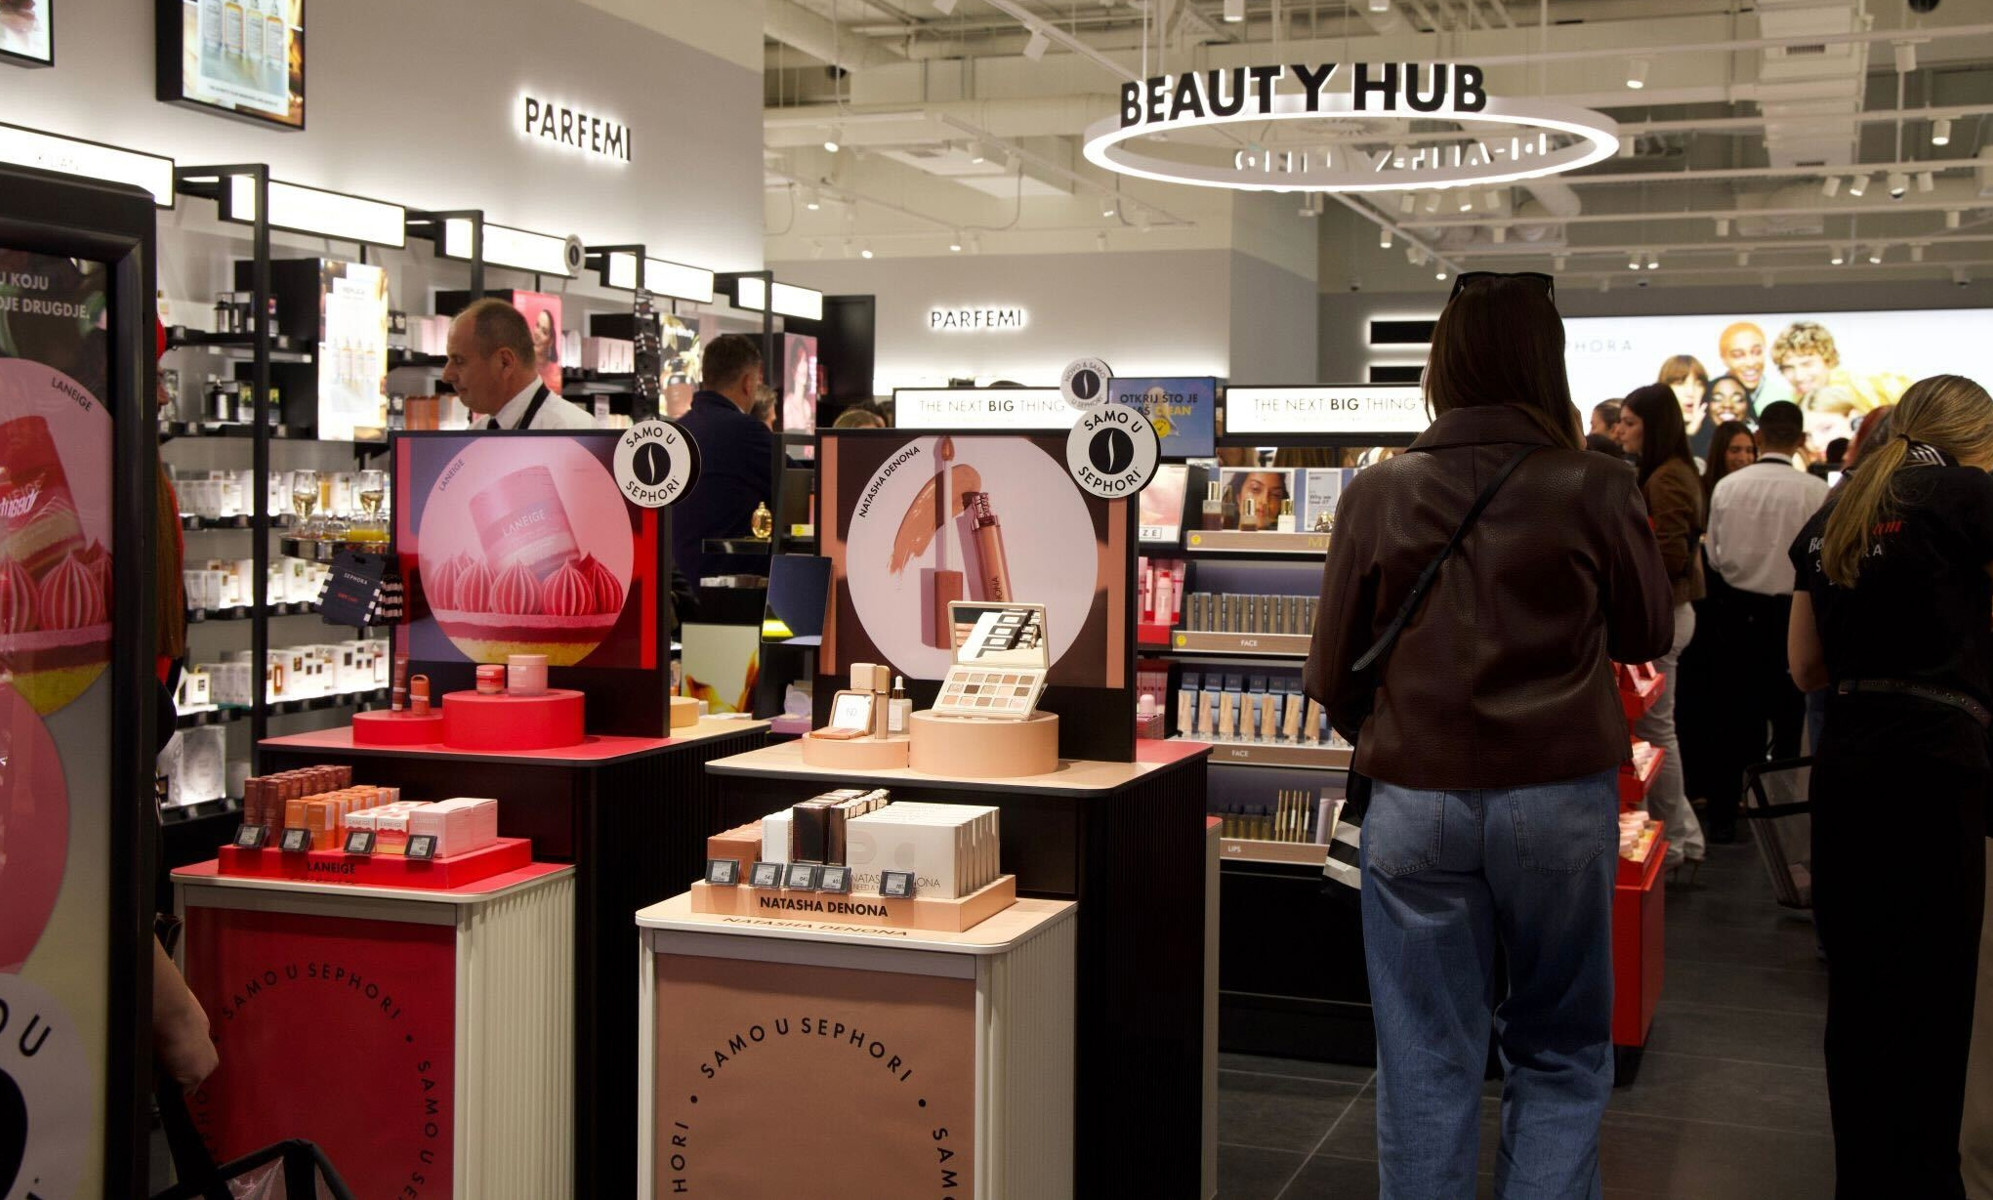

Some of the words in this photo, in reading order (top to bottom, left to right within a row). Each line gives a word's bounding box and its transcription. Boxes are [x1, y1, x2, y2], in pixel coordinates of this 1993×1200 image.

[1121, 64, 1338, 128] BEAUTY
[1353, 63, 1487, 113] HUB
[526, 97, 631, 161] PARFEMI
[11, 273, 48, 290] KOJU
[23, 299, 90, 319] DRUGDJE.
[931, 310, 1021, 328] PARFEMI
[51, 376, 93, 413] LANEIGE
[920, 400, 942, 412] THE
[949, 400, 982, 412] NEXT
[988, 400, 1015, 412] BIG
[1020, 400, 1065, 412] THING
[1120, 394, 1159, 404] OTKRIJ
[1187, 393, 1198, 403] JE
[1255, 398, 1280, 412] THE
[1286, 398, 1324, 411] NEXT
[1330, 398, 1360, 411] BIG
[1084, 411, 1129, 431] SAMO
[1131, 421, 1143, 433] U
[626, 427, 663, 448] SAMO
[665, 433, 676, 445] U
[438, 459, 465, 492] LANEIGE
[859, 476, 886, 518] NATASHA
[884, 446, 921, 477] DENONA
[1078, 465, 1142, 492] SEPHORI
[626, 478, 680, 502] SEPHORI
[503, 508, 547, 536] LANEIGE
[1227, 845, 1242, 853] LIPS
[306, 862, 356, 874] LANEIGE
[851, 873, 880, 885] NATAS
[760, 896, 824, 912] NATASHA
[827, 901, 888, 917] DENONA
[222, 970, 277, 1021] SAMO
[285, 964, 298, 980] U
[307, 962, 401, 1020] SEPHORI
[19, 1014, 52, 1057] U
[700, 1025, 765, 1079] SAMO
[775, 1018, 789, 1035] U
[801, 1017, 913, 1082] SEPHORI
[418, 1060, 439, 1138] SAMO
[420, 1150, 435, 1165] U
[671, 1121, 689, 1193] HORI
[932, 1127, 958, 1200] SAM
